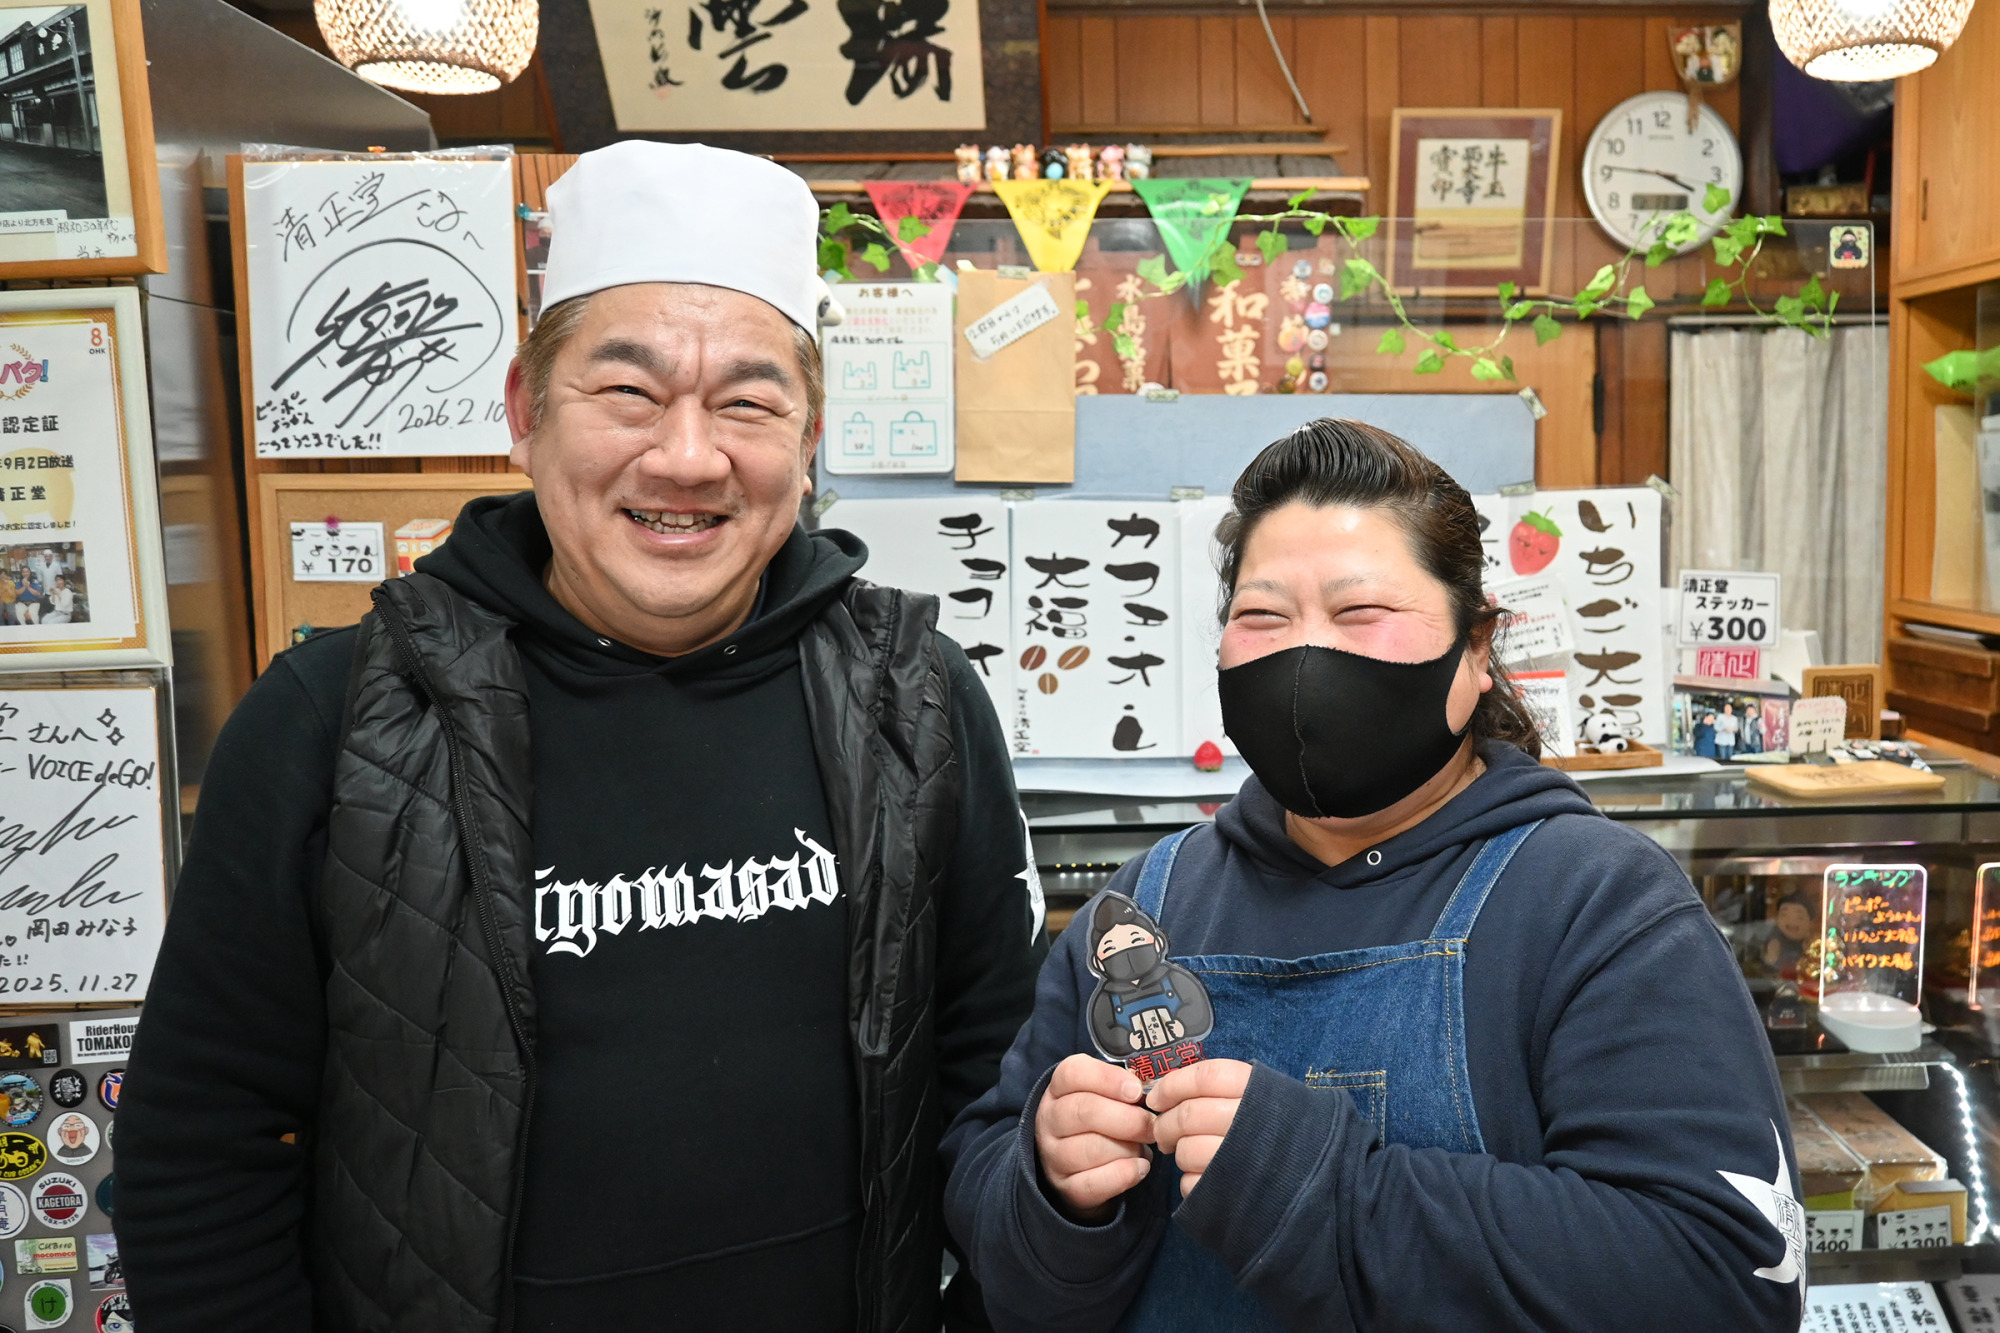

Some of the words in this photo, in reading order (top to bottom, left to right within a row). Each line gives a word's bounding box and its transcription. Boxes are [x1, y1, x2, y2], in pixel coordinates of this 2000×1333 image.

[1627, 118, 1643, 135] 11
[1654, 111, 1671, 128] 12
[1607, 138, 1625, 155] 10
[1702, 139, 1714, 156] 2
[1601, 166, 1613, 181] 9
[1710, 166, 1722, 184] 3
[1608, 192, 1620, 208] 8
[1628, 214, 1639, 230] 7
[859, 287, 913, 298] お客様へ
[91, 327, 103, 347] 8
[1684, 578, 1729, 593] 清正堂
[1024, 552, 1091, 639] 大福
[1696, 597, 1769, 611] ステッカー
[1129, 1041, 1200, 1081] 清正堂
[39, 1177, 77, 1190] SUZUKI
[38, 1196, 82, 1208] KAGETORA
[33, 1251, 77, 1260] mocomoco
[41, 1297, 57, 1314] け
